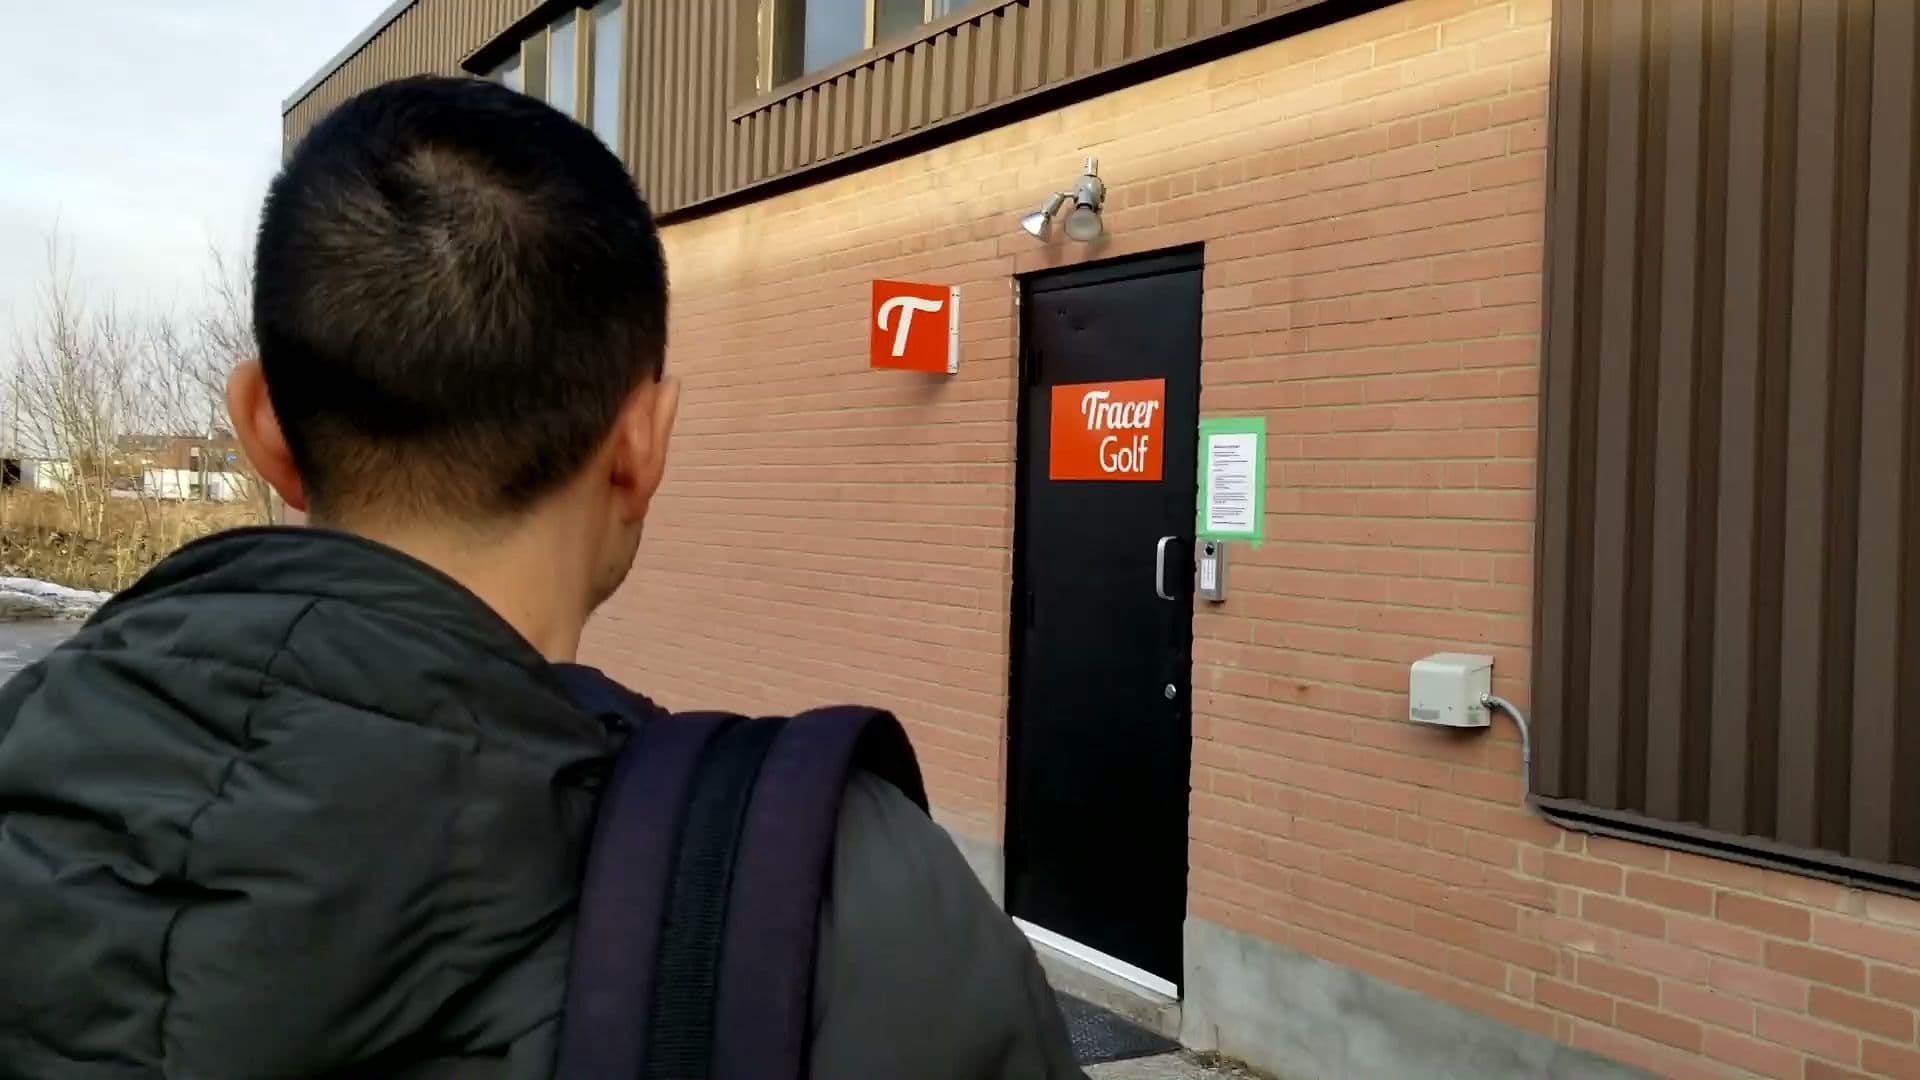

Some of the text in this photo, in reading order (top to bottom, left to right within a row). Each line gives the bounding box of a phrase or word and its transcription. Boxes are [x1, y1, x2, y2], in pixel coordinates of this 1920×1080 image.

[877, 296, 944, 357] T
[1081, 390, 1159, 430] Tracer
[1099, 435, 1149, 473] Golf
